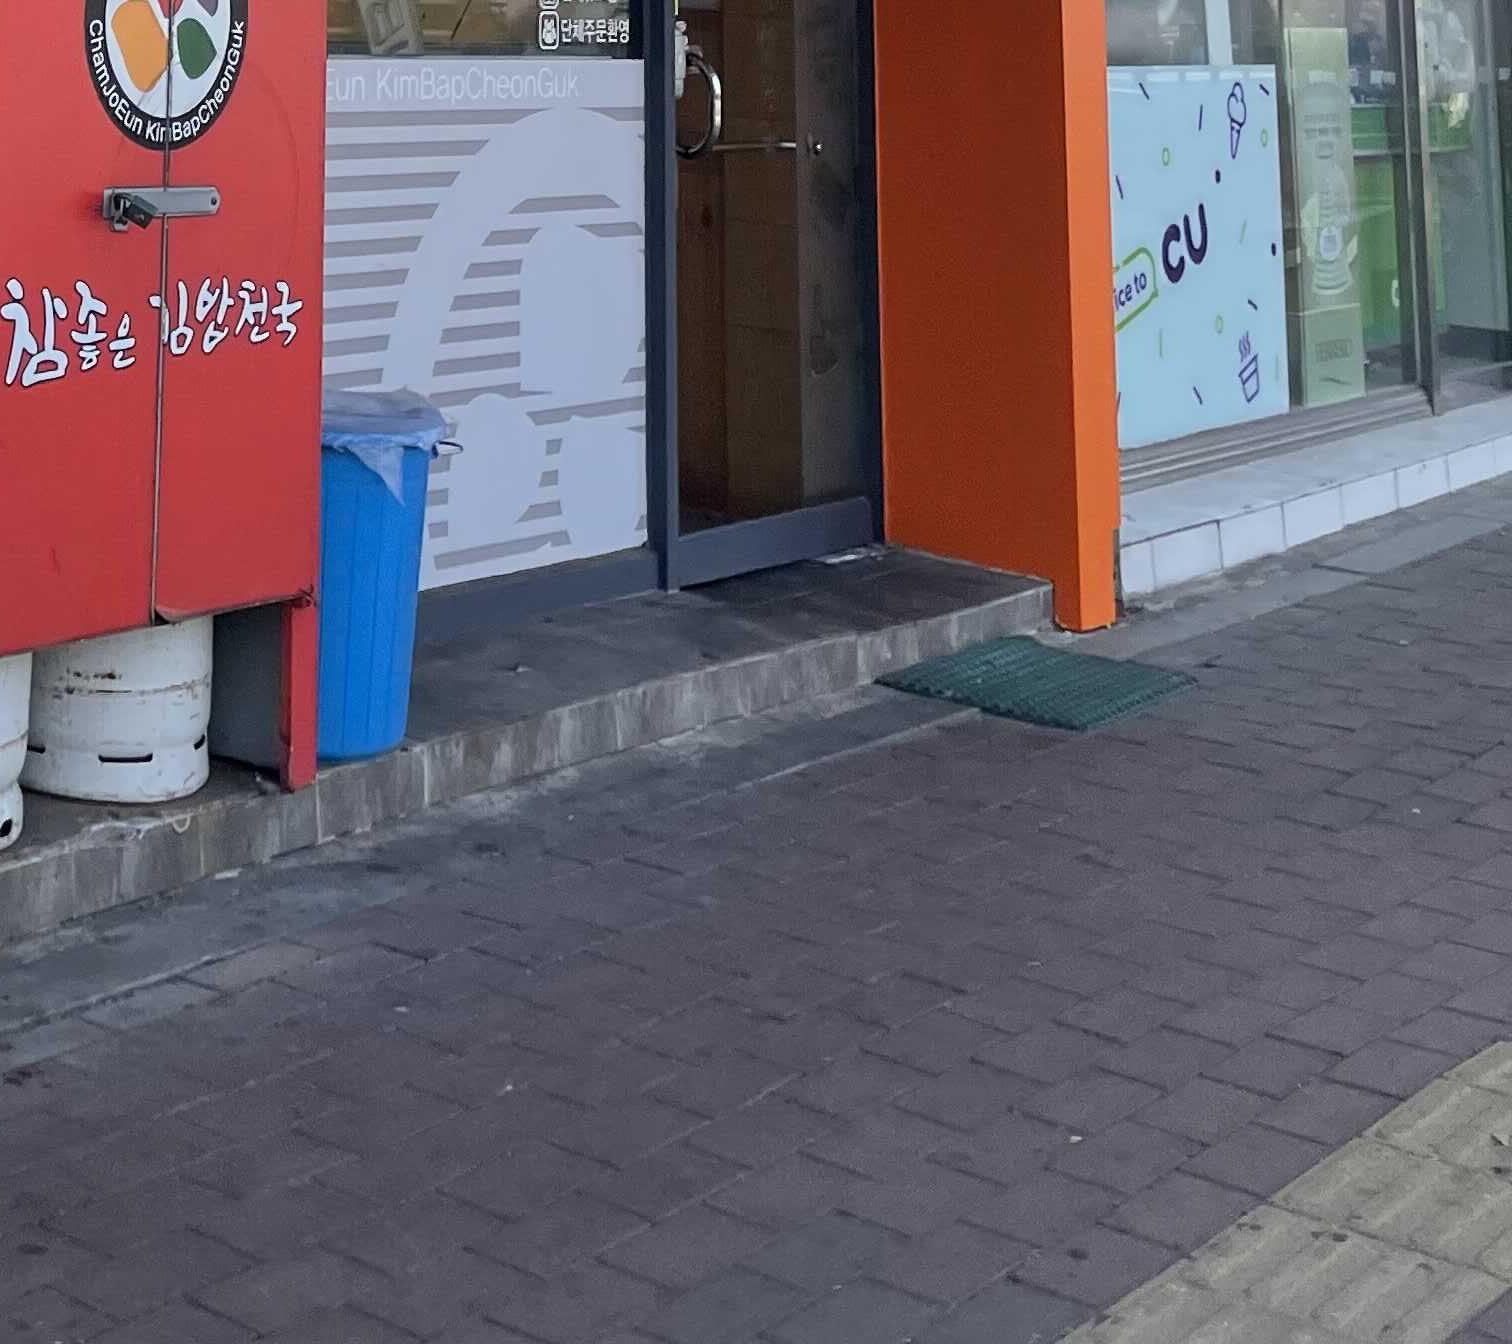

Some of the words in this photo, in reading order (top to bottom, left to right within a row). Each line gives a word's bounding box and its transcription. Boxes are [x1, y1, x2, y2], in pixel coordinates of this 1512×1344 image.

[88, 18, 143, 136] ChamJoEun
[376, 66, 580, 106] KimBapCheonGuk
[1161, 202, 1208, 284] CU
[0, 276, 137, 388] 참좋은
[147, 275, 304, 356] 김밥천국
